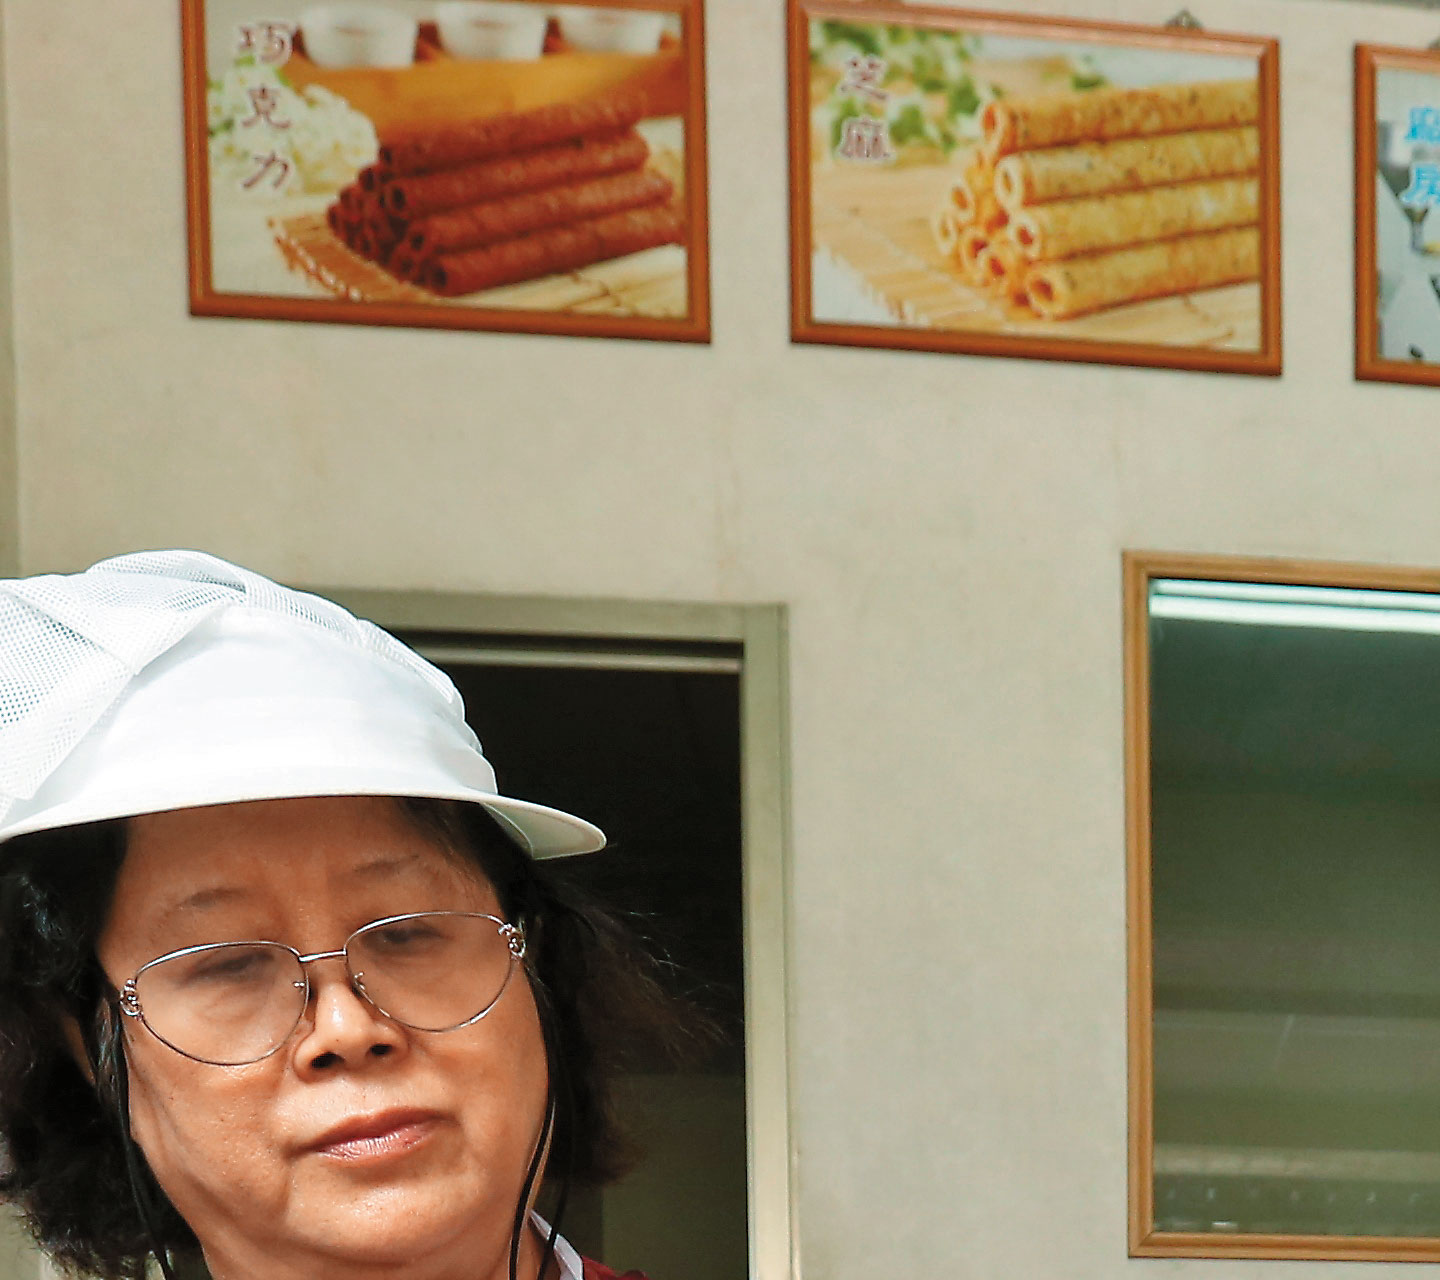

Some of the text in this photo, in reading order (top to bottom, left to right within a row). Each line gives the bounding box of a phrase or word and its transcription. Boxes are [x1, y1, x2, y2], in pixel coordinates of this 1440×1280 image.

[238, 20, 292, 190] 巧克力
[840, 58, 890, 158] 芝麻
